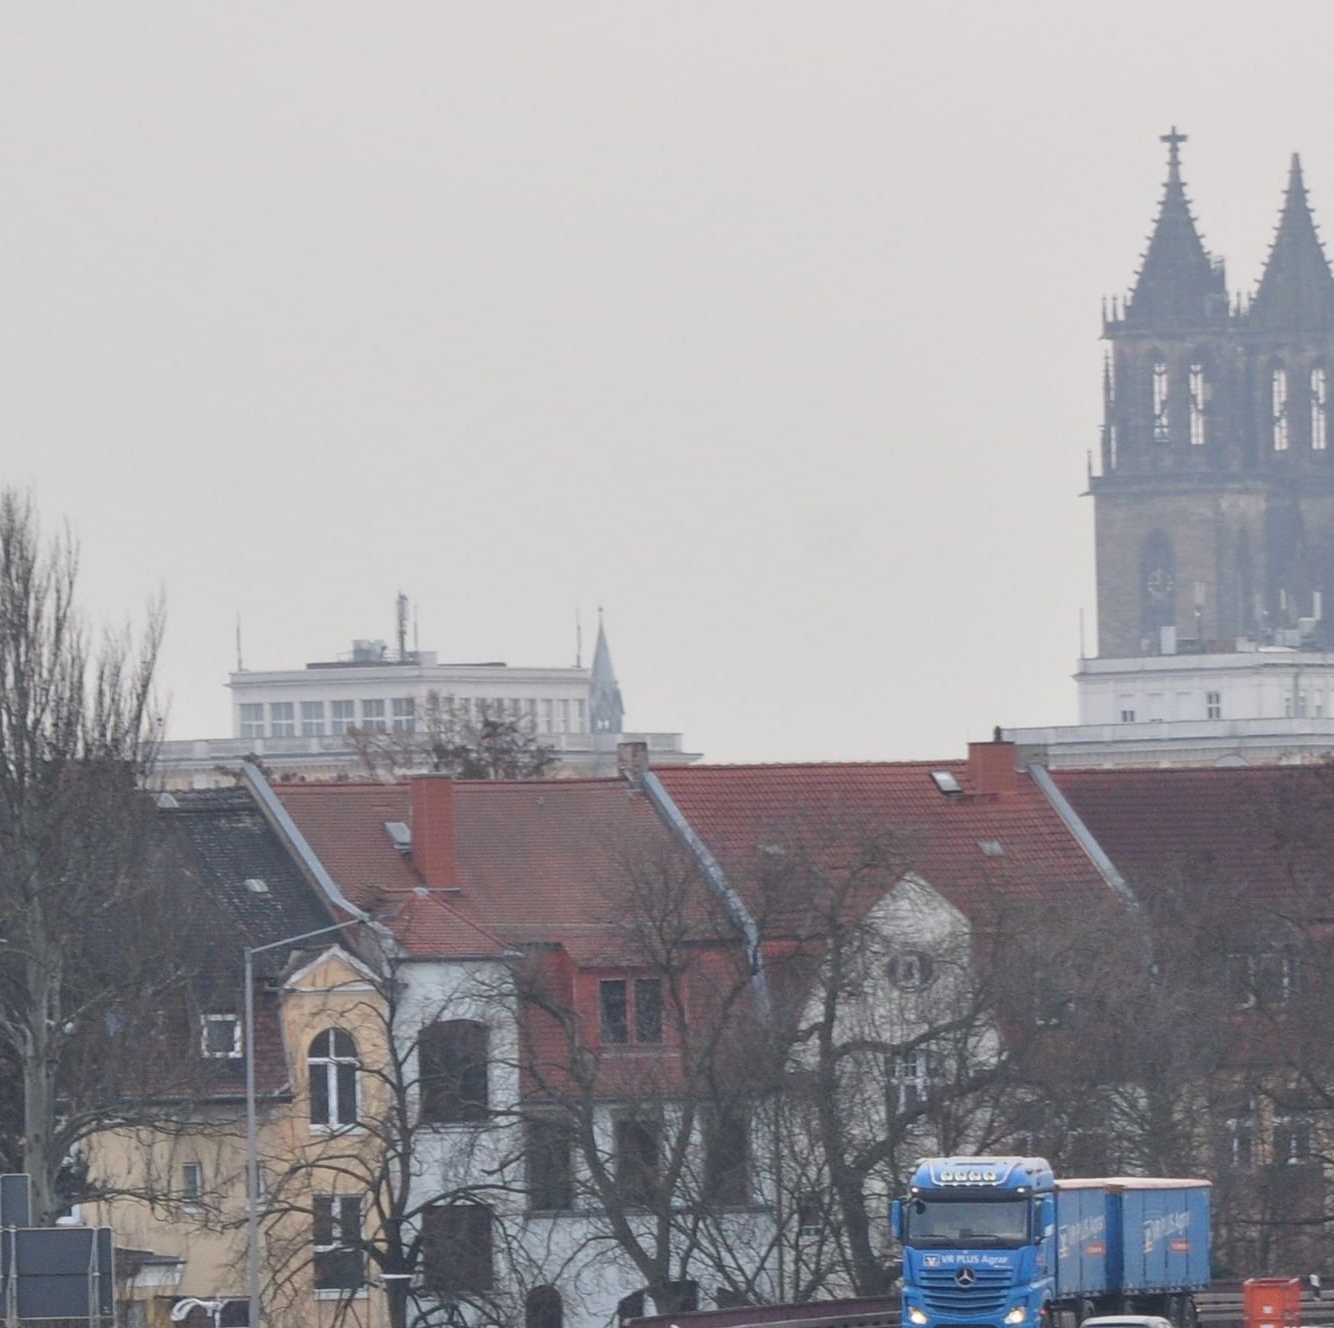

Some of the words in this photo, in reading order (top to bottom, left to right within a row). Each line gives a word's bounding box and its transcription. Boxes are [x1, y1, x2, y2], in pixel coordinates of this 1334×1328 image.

[941, 1255, 954, 1263] VR
[956, 1254, 979, 1264] PLUS
[981, 1255, 1008, 1265] Agrar
